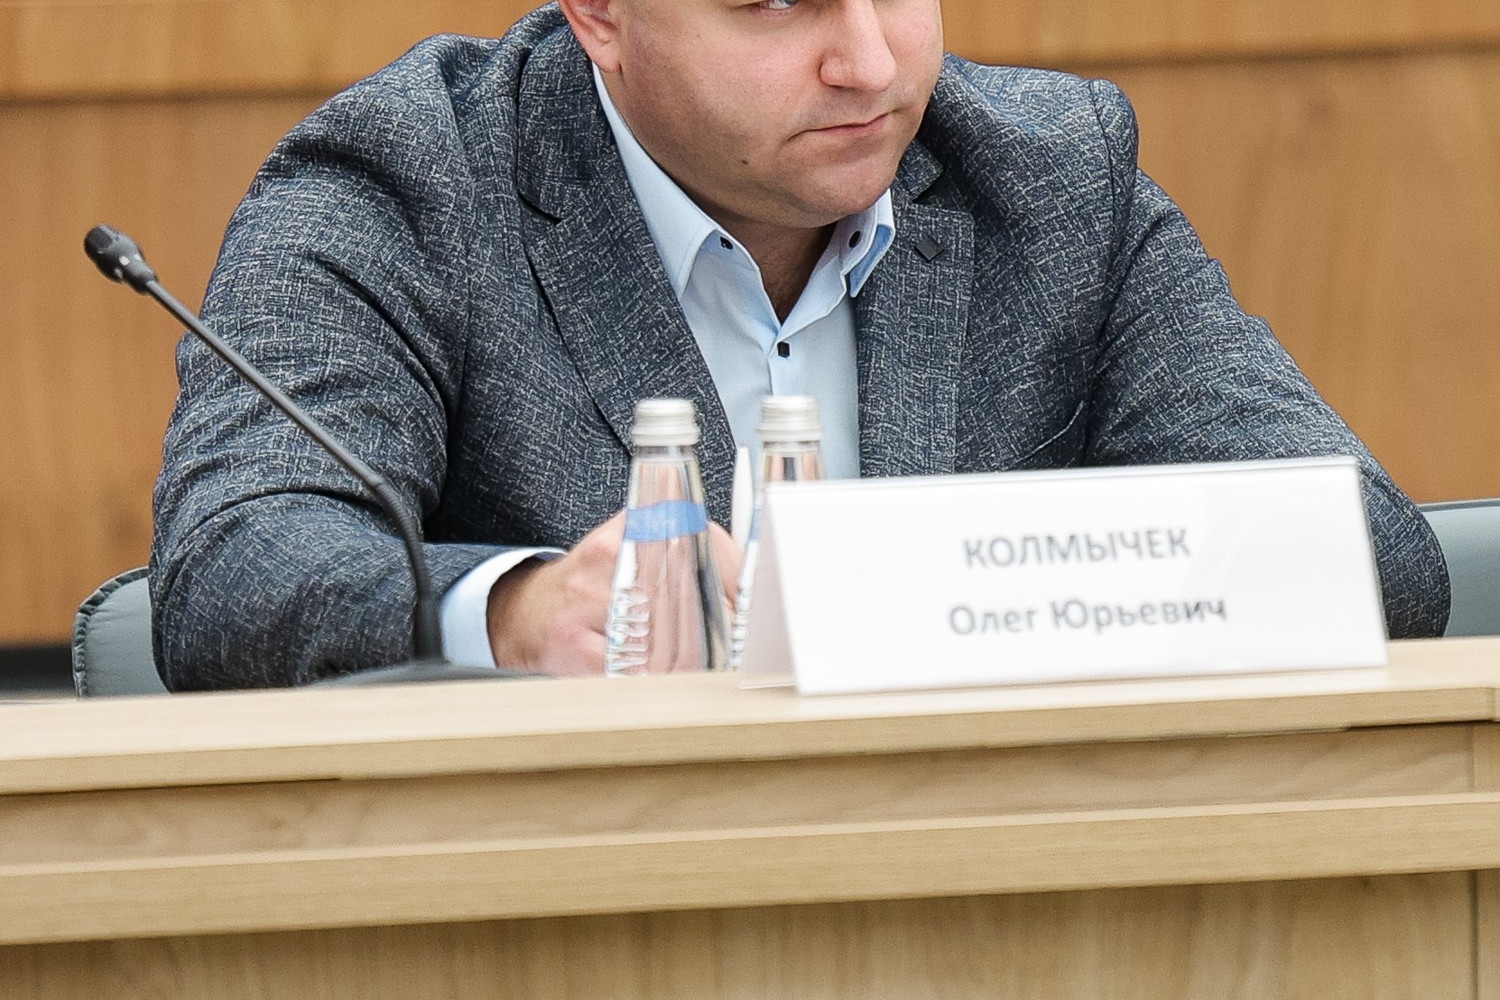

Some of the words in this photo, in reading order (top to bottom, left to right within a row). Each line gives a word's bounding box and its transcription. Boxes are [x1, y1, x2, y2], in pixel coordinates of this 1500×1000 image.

[962, 527, 1192, 568] КОЛМЫЧЕК
[947, 603, 1037, 636] Олег
[1048, 597, 1228, 634] Юрьевич
